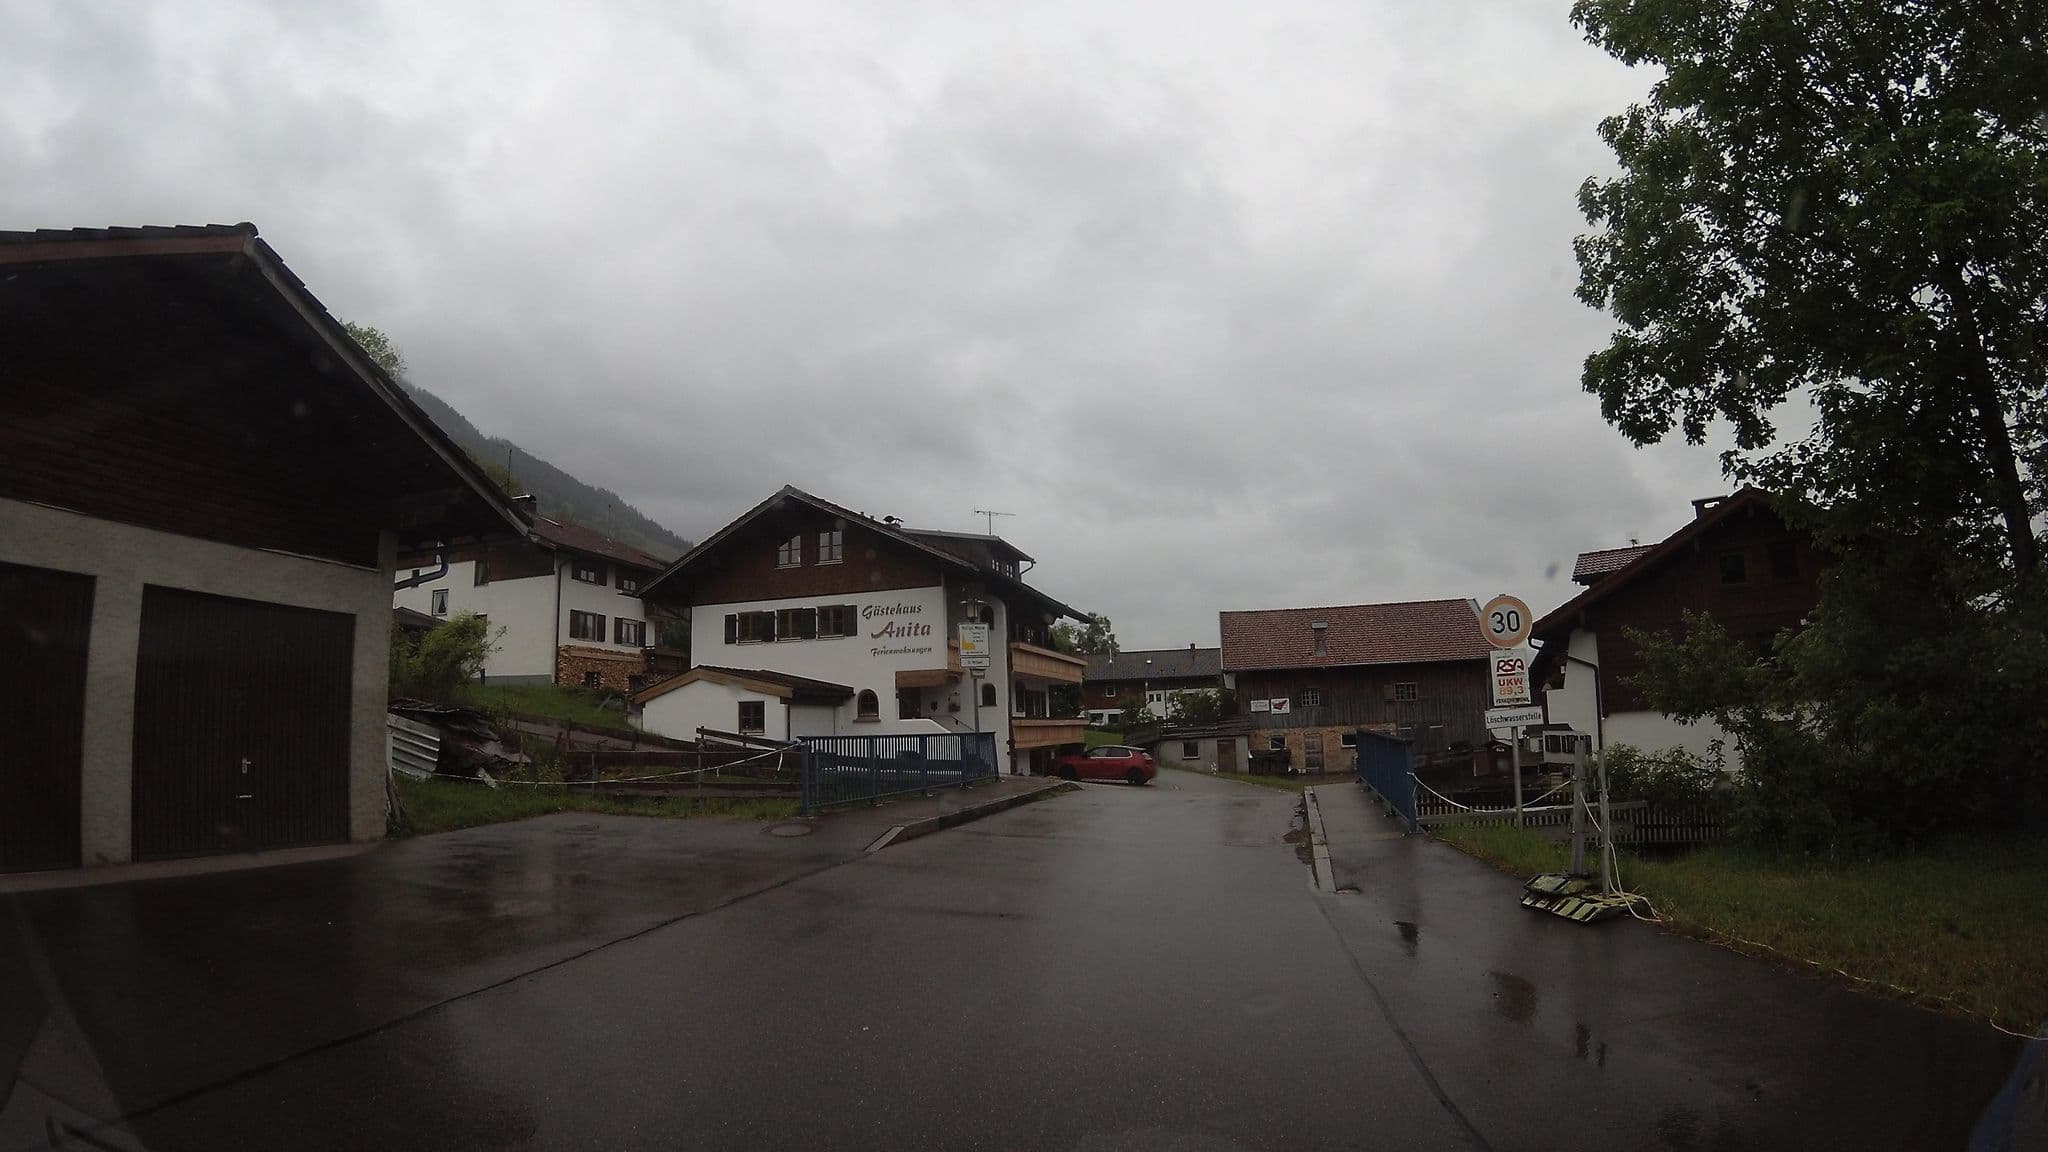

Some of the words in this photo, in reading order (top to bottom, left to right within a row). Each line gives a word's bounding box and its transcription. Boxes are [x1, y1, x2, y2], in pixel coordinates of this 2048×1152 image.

[862, 603, 922, 619] Gästehaus
[1491, 610, 1520, 633] 30
[871, 621, 931, 639] Anita
[1496, 658, 1525, 673] RSA
[1498, 678, 1523, 687] UKW
